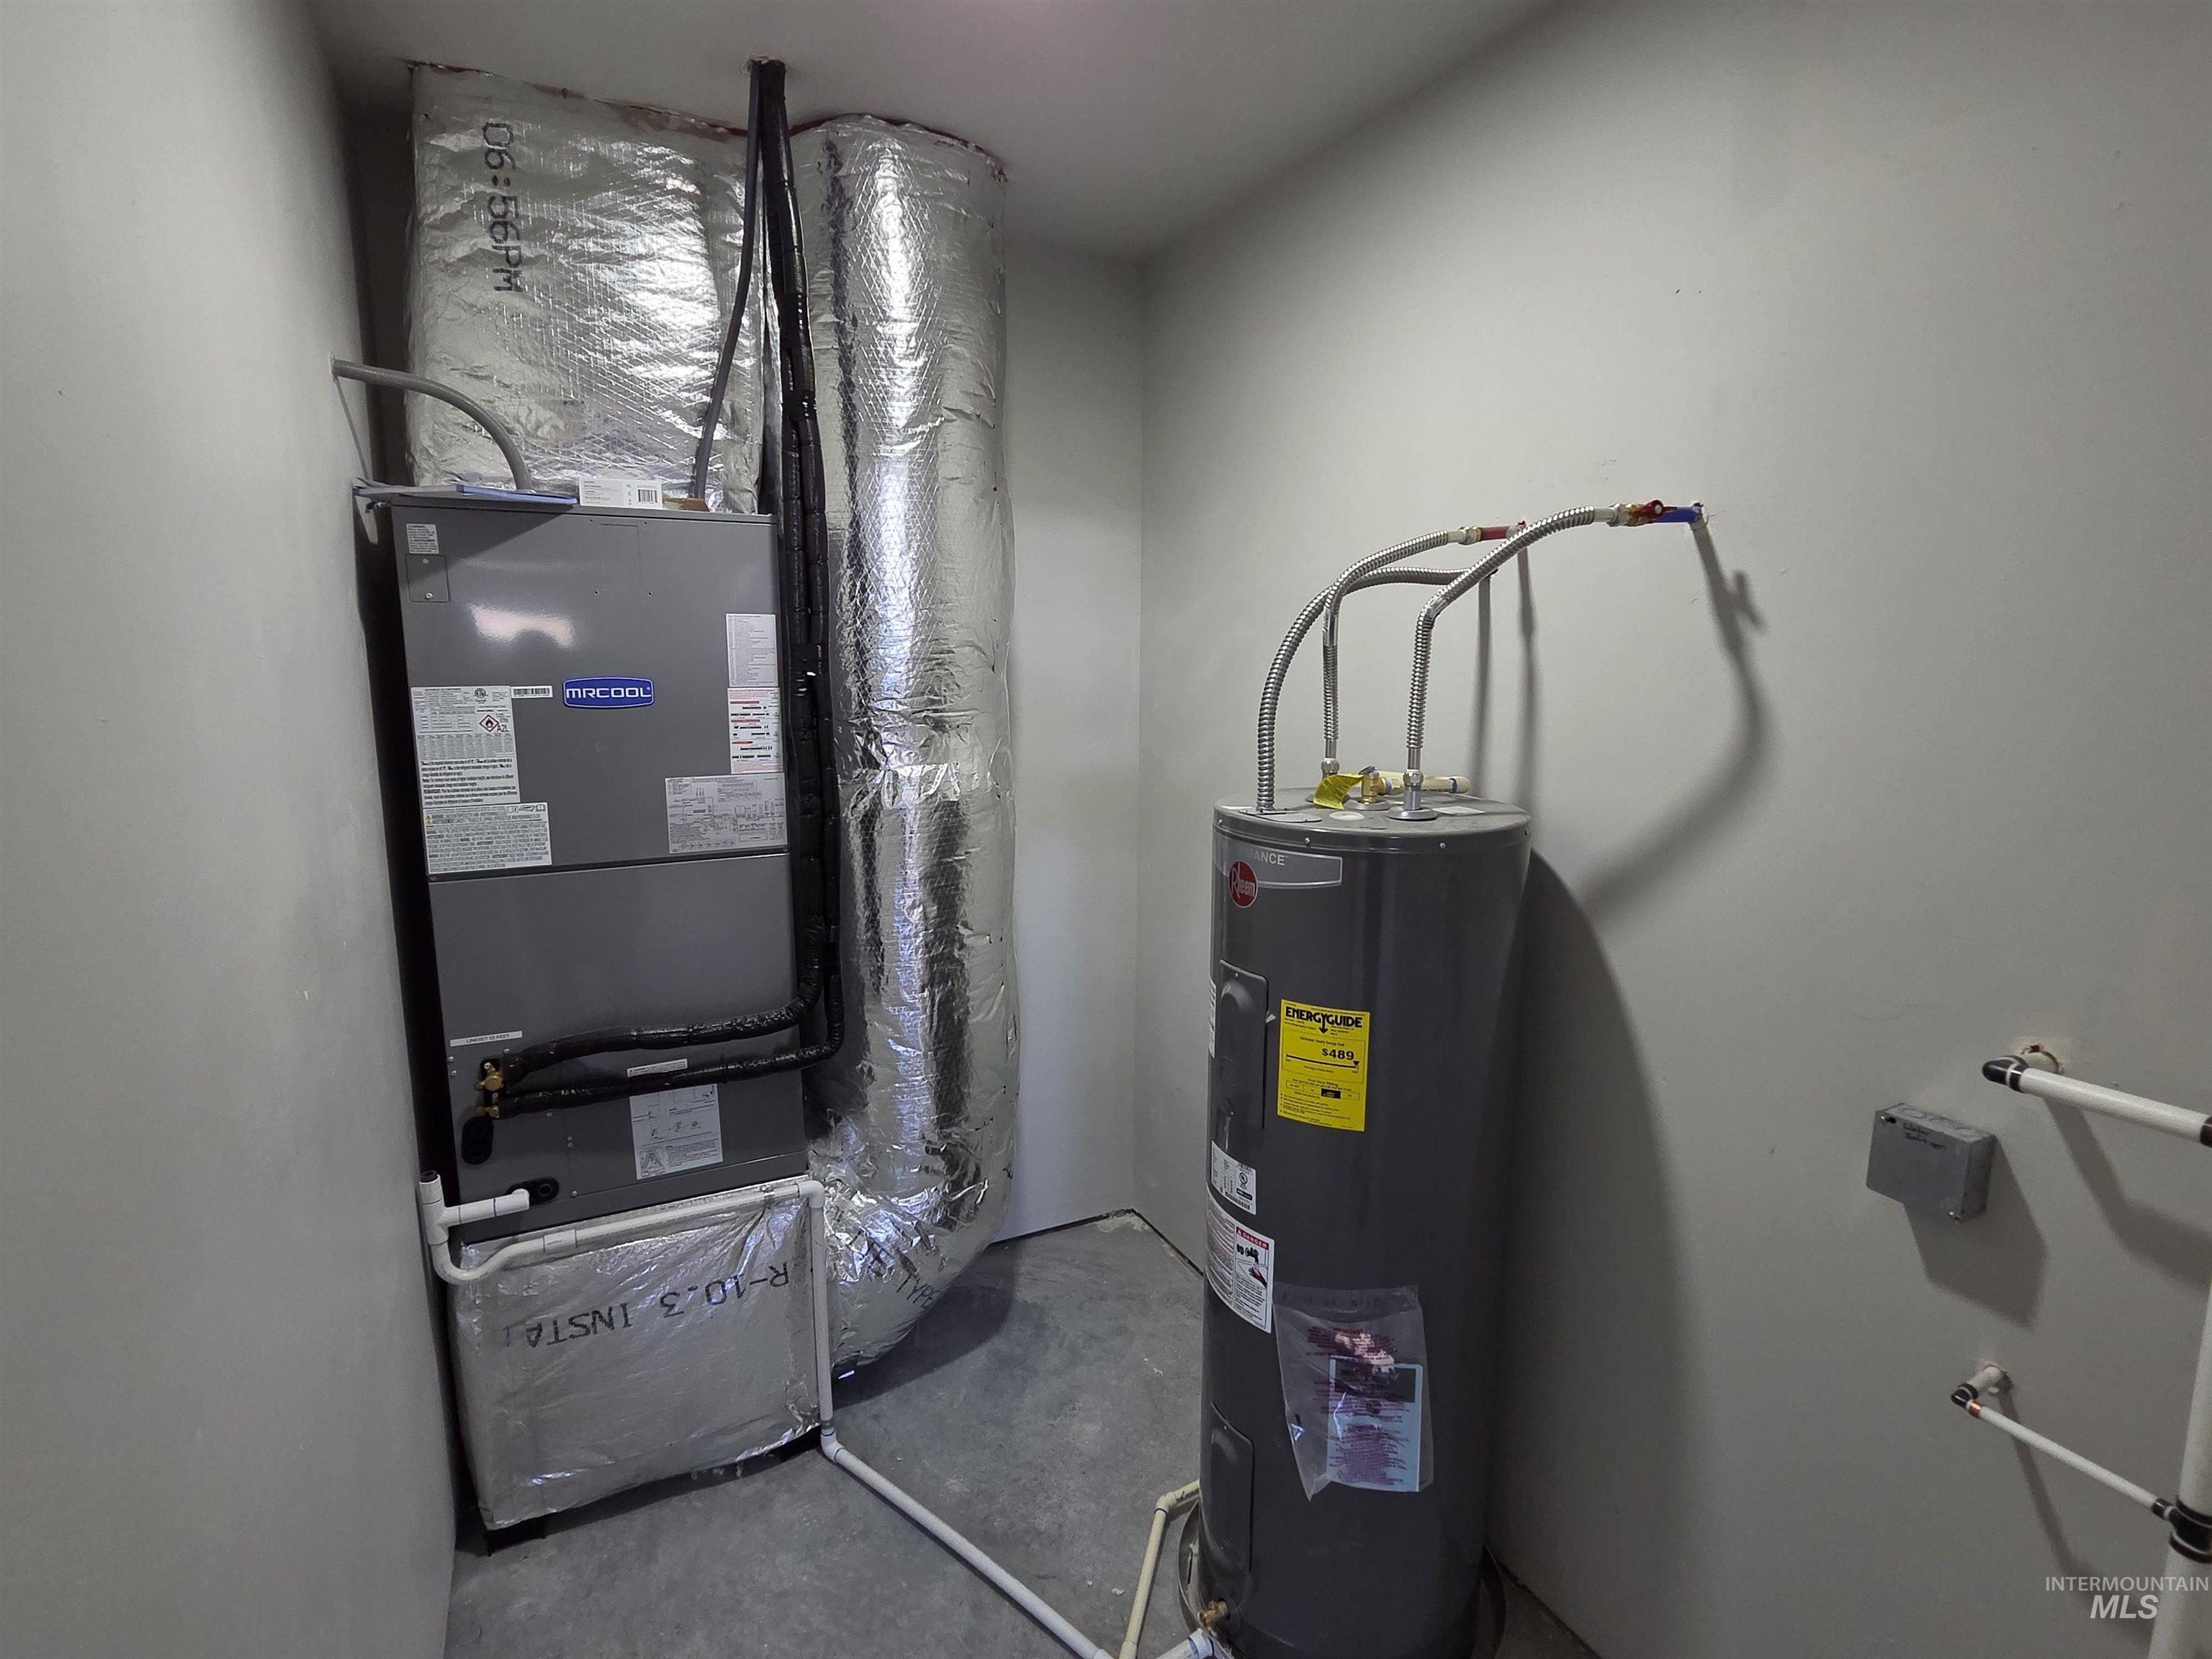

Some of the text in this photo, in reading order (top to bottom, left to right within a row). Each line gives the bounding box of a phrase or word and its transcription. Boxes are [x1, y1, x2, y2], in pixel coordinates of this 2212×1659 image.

[482, 122, 523, 292] 06:56PM
[566, 687, 652, 698] MRCOOL
[1231, 862, 1255, 899] Rheem
[1285, 1006, 1363, 1030] ENERGYGUIDE
[1321, 1048, 1354, 1061] $489
[1242, 1232, 1268, 1249] DANGER
[660, 1262, 790, 1318] R-10.3
